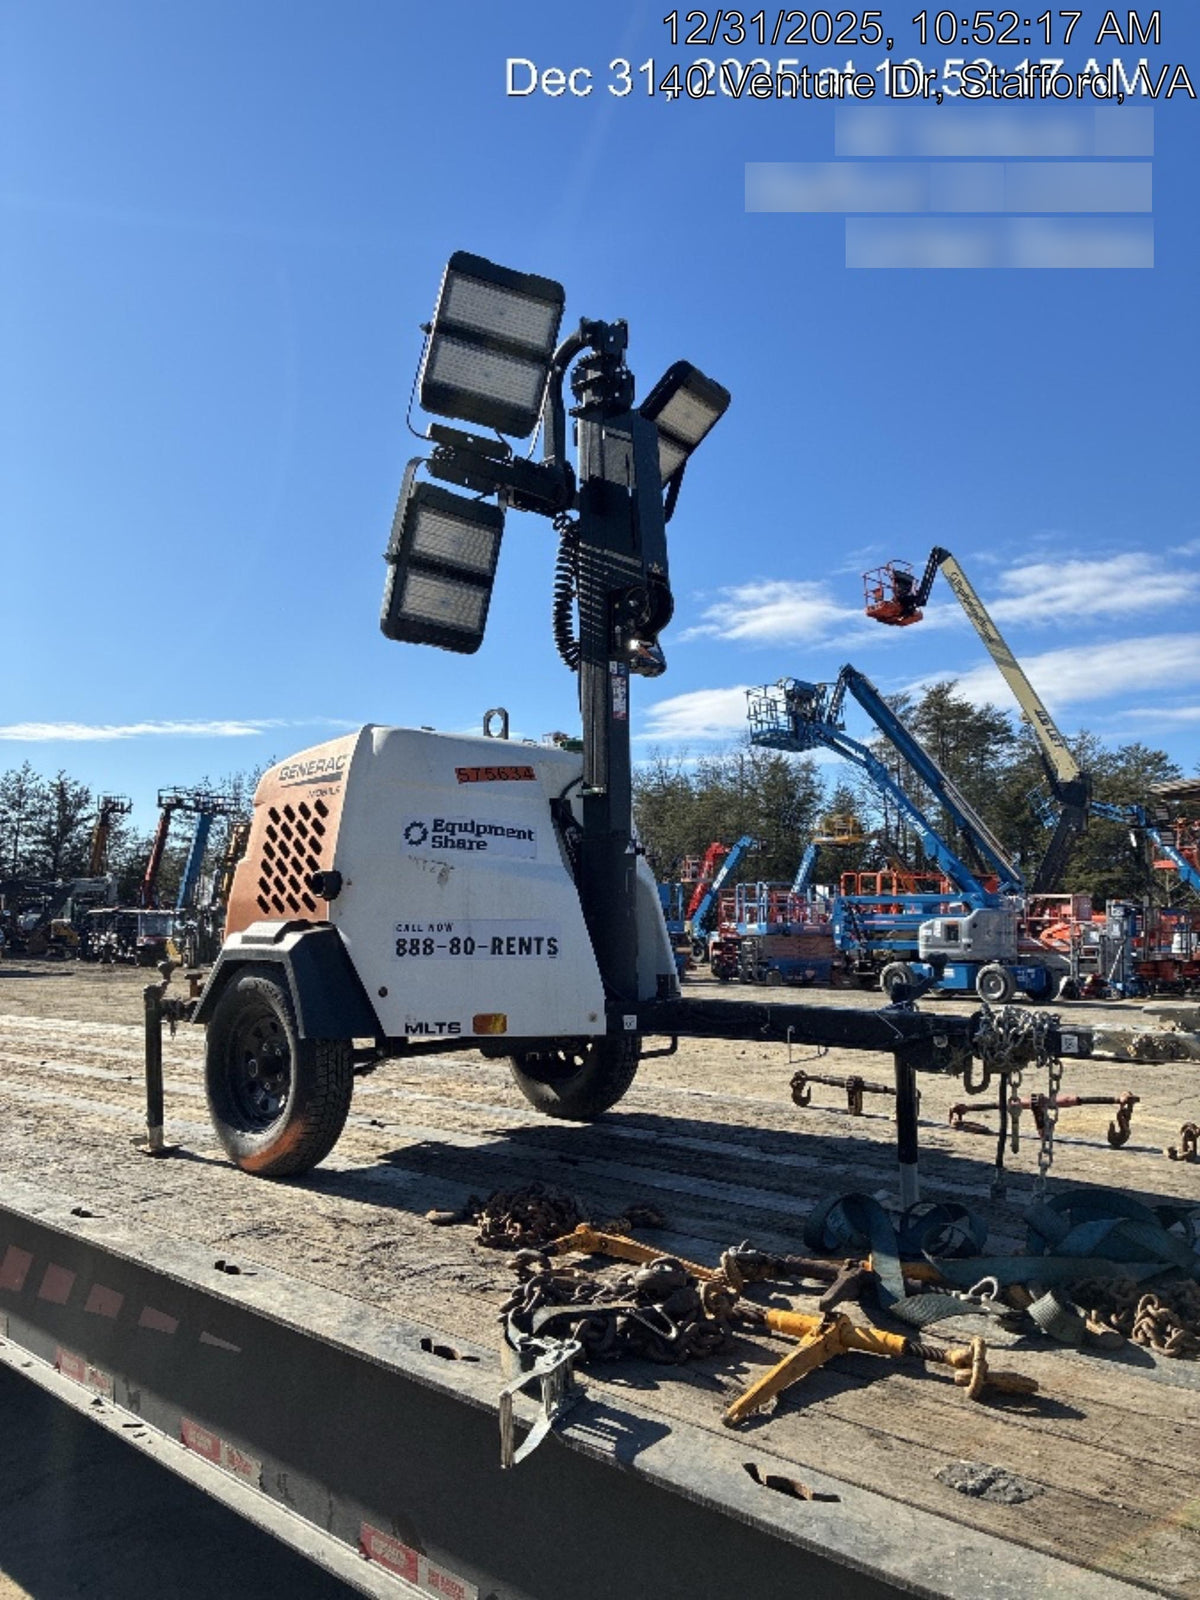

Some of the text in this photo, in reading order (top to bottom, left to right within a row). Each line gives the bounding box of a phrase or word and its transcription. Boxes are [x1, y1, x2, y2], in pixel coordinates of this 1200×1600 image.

[279, 754, 347, 780] GENERAC
[432, 818, 535, 841] Equipment
[431, 835, 488, 850] Share
[396, 936, 559, 957] 888-80-RENTS
[405, 1021, 461, 1034] MLTS
